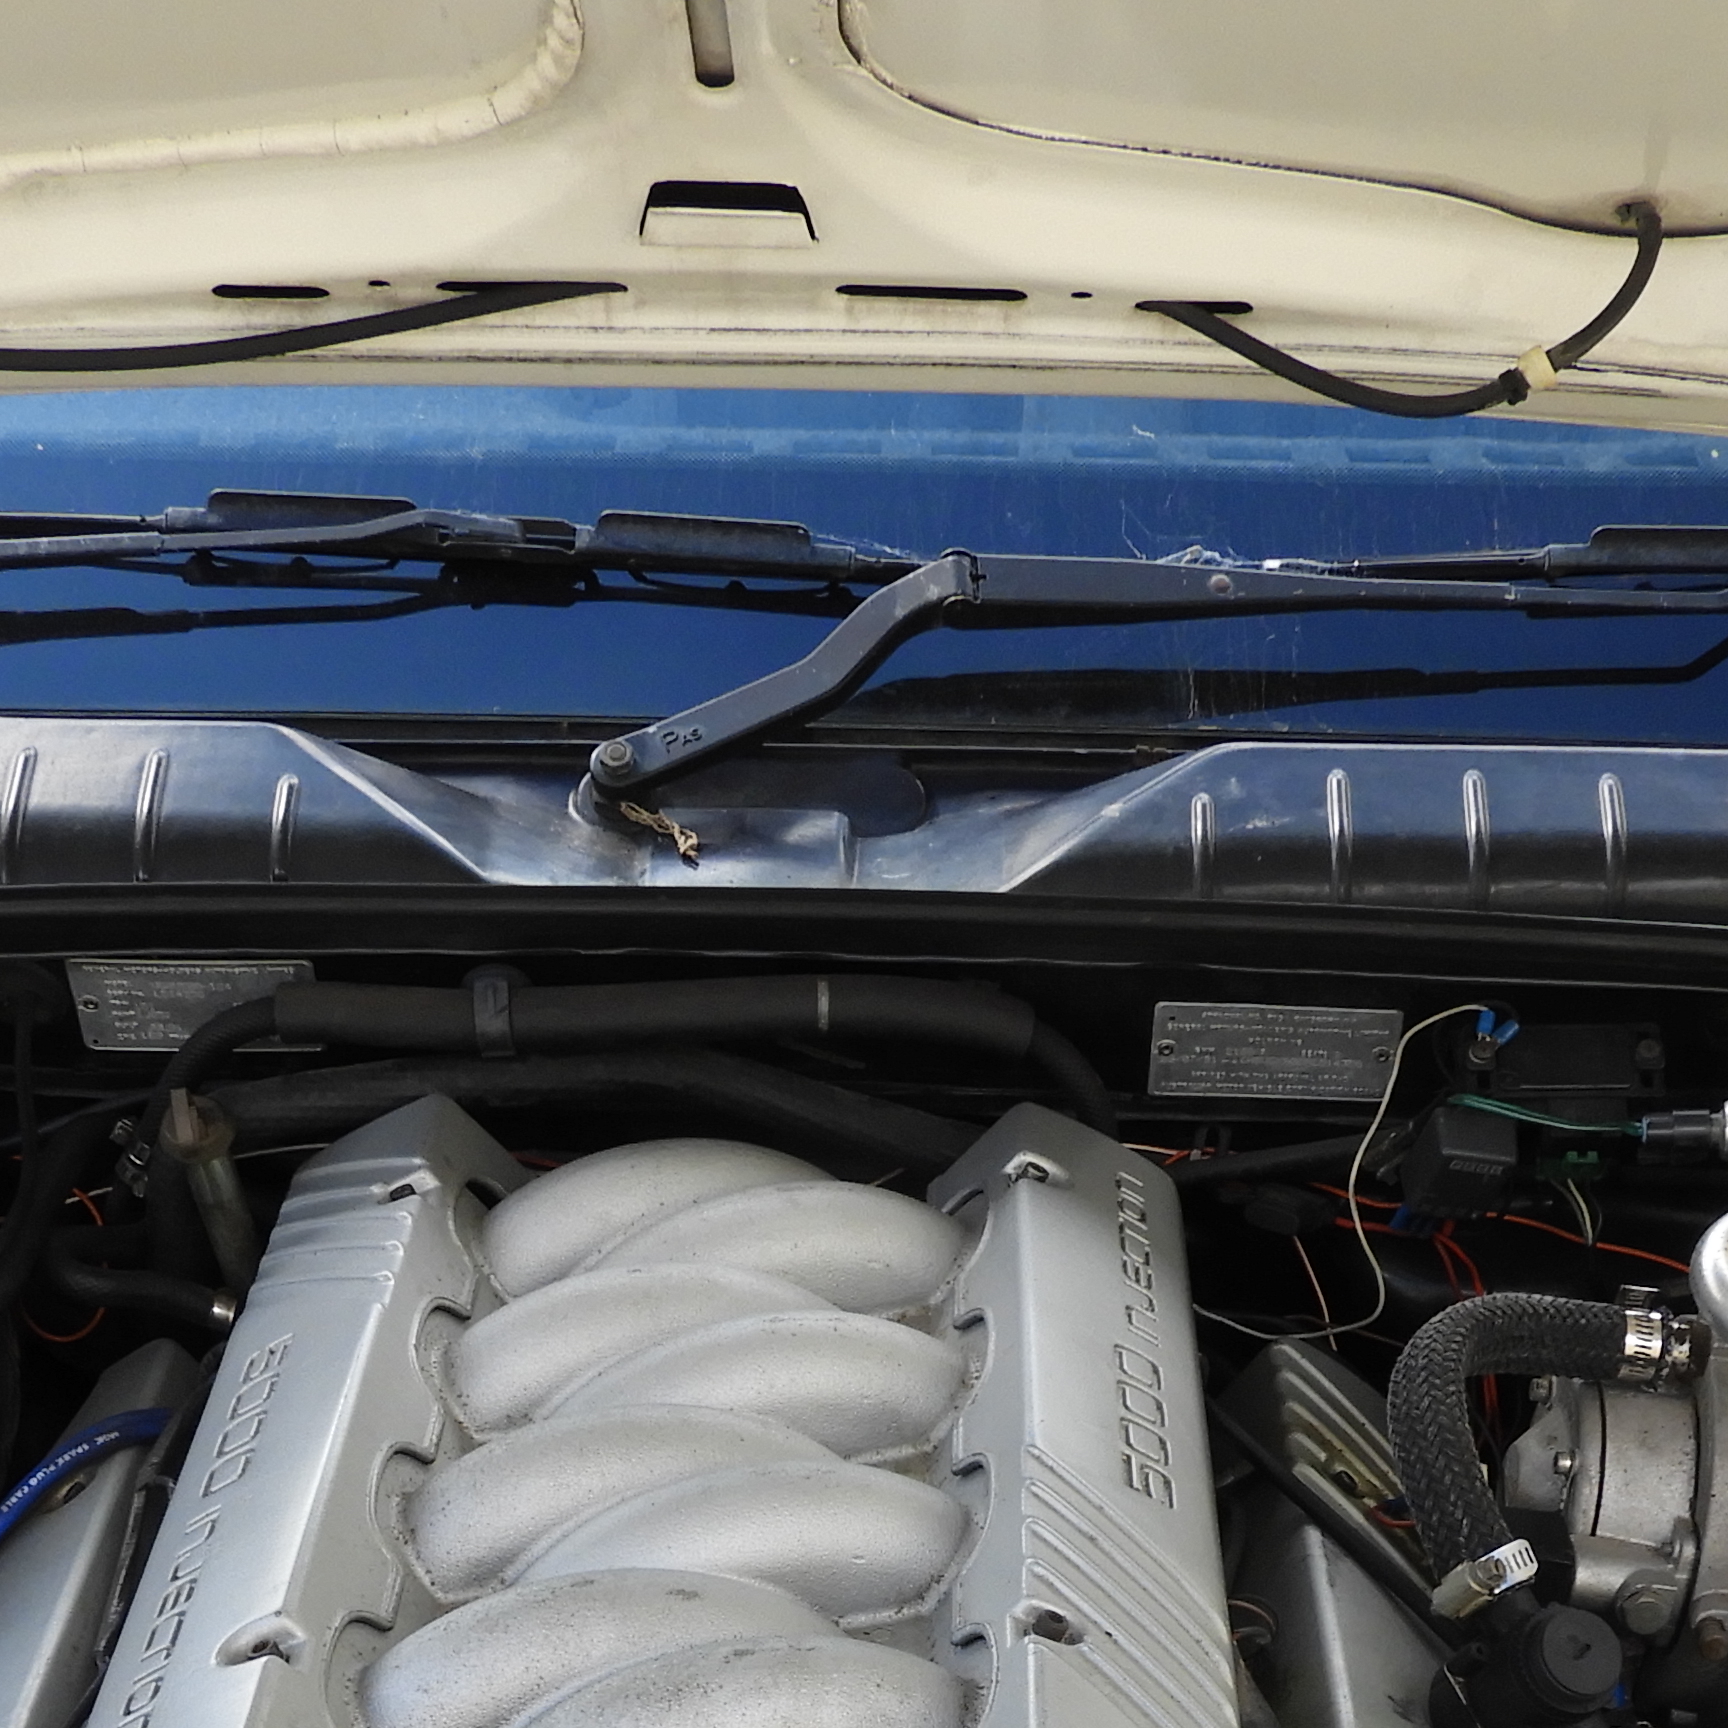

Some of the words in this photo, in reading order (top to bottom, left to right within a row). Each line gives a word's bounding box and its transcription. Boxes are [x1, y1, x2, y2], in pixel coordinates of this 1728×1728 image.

[198, 1332, 295, 1499] 5000
[1113, 1343, 1178, 1510] 5000
[0, 1485, 30, 1514] CABLE
[27, 1464, 57, 1487] PLUG
